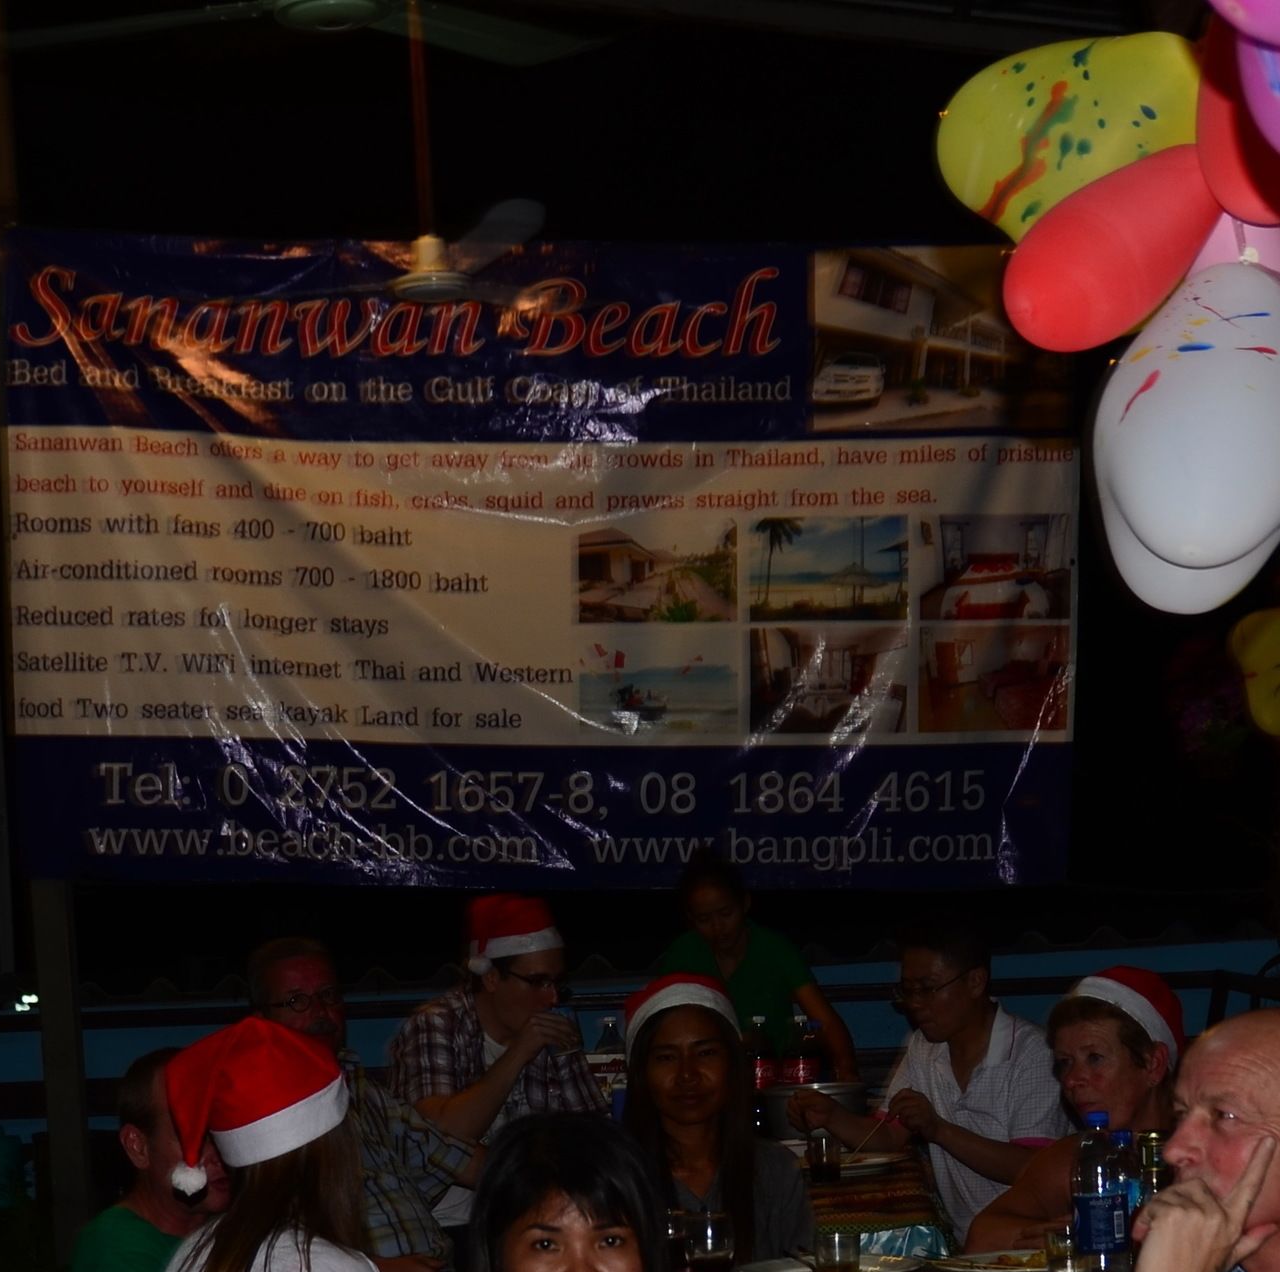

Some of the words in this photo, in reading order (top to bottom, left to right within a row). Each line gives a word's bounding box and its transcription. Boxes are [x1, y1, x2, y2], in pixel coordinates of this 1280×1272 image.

[9, 263, 487, 358] Sananwan
[498, 266, 782, 358] Beach
[12, 358, 68, 386] Bed
[83, 363, 141, 389] and
[151, 365, 295, 401] Breakfast
[311, 379, 347, 402] on
[365, 374, 414, 402] the
[429, 374, 496, 402] Gulf
[512, 375, 602, 407] Coa
[659, 374, 793, 403] Thailand
[15, 432, 123, 452] Sananwan
[135, 435, 199, 455] Beach
[209, 438, 263, 459] offers
[273, 447, 288, 463] a
[298, 450, 342, 470] way
[354, 448, 375, 468] to
[386, 449, 419, 473] get
[431, 452, 489, 473] away
[500, 449, 549, 469] from
[695, 449, 715, 467] in
[726, 447, 825, 470] Thailand,
[836, 446, 889, 466] have
[899, 445, 956, 465] miles
[968, 444, 990, 464] of
[996, 443, 1075, 469] pristine
[15, 473, 77, 493] beach
[89, 477, 109, 494] to
[121, 475, 204, 498] yourself
[215, 480, 253, 499] and
[263, 481, 307, 502] dine
[319, 489, 344, 505] on
[356, 487, 400, 510] fish,
[485, 490, 543, 512] squid
[555, 490, 594, 509] and
[606, 492, 685, 512] prawns
[695, 488, 783, 512] straight
[790, 487, 839, 507] from
[851, 486, 885, 506] the
[896, 487, 938, 505] sea.
[15, 513, 92, 535] Rooms
[106, 512, 159, 535] with
[172, 515, 221, 537] fans
[233, 518, 275, 540] 400
[306, 521, 346, 542] 700
[360, 524, 413, 546] baht
[17, 558, 198, 582] Air-conditioned
[213, 566, 283, 586] rooms
[295, 567, 335, 588] 700
[369, 569, 422, 591] 1800
[435, 570, 489, 593] baht
[17, 605, 114, 627] Reduced
[127, 607, 186, 627] rates
[199, 607, 230, 627] for
[244, 608, 318, 635] longer
[330, 614, 390, 637] stays
[18, 651, 108, 673] Satellite
[121, 653, 168, 673] T.V.
[182, 653, 236, 673] WiFi
[250, 653, 343, 679] internet
[355, 659, 406, 682] Thai
[419, 661, 461, 682] and
[475, 661, 573, 685] Western
[18, 698, 64, 719] food
[76, 699, 128, 721] Two
[141, 702, 214, 722] seater
[226, 703, 266, 721] sea
[280, 701, 350, 726] kayak
[361, 705, 420, 727] Land
[432, 707, 462, 728] for
[475, 708, 522, 729] sale
[98, 761, 192, 806] Tel:
[222, 763, 251, 807] 0
[281, 764, 398, 810] 2752
[429, 769, 610, 820] 1657-8,
[639, 772, 697, 815] 08
[728, 771, 845, 815] 1864
[876, 769, 986, 813] 4615
[87, 819, 538, 865] www.beach-bb.com
[590, 826, 994, 873] wwwbangpli.com
